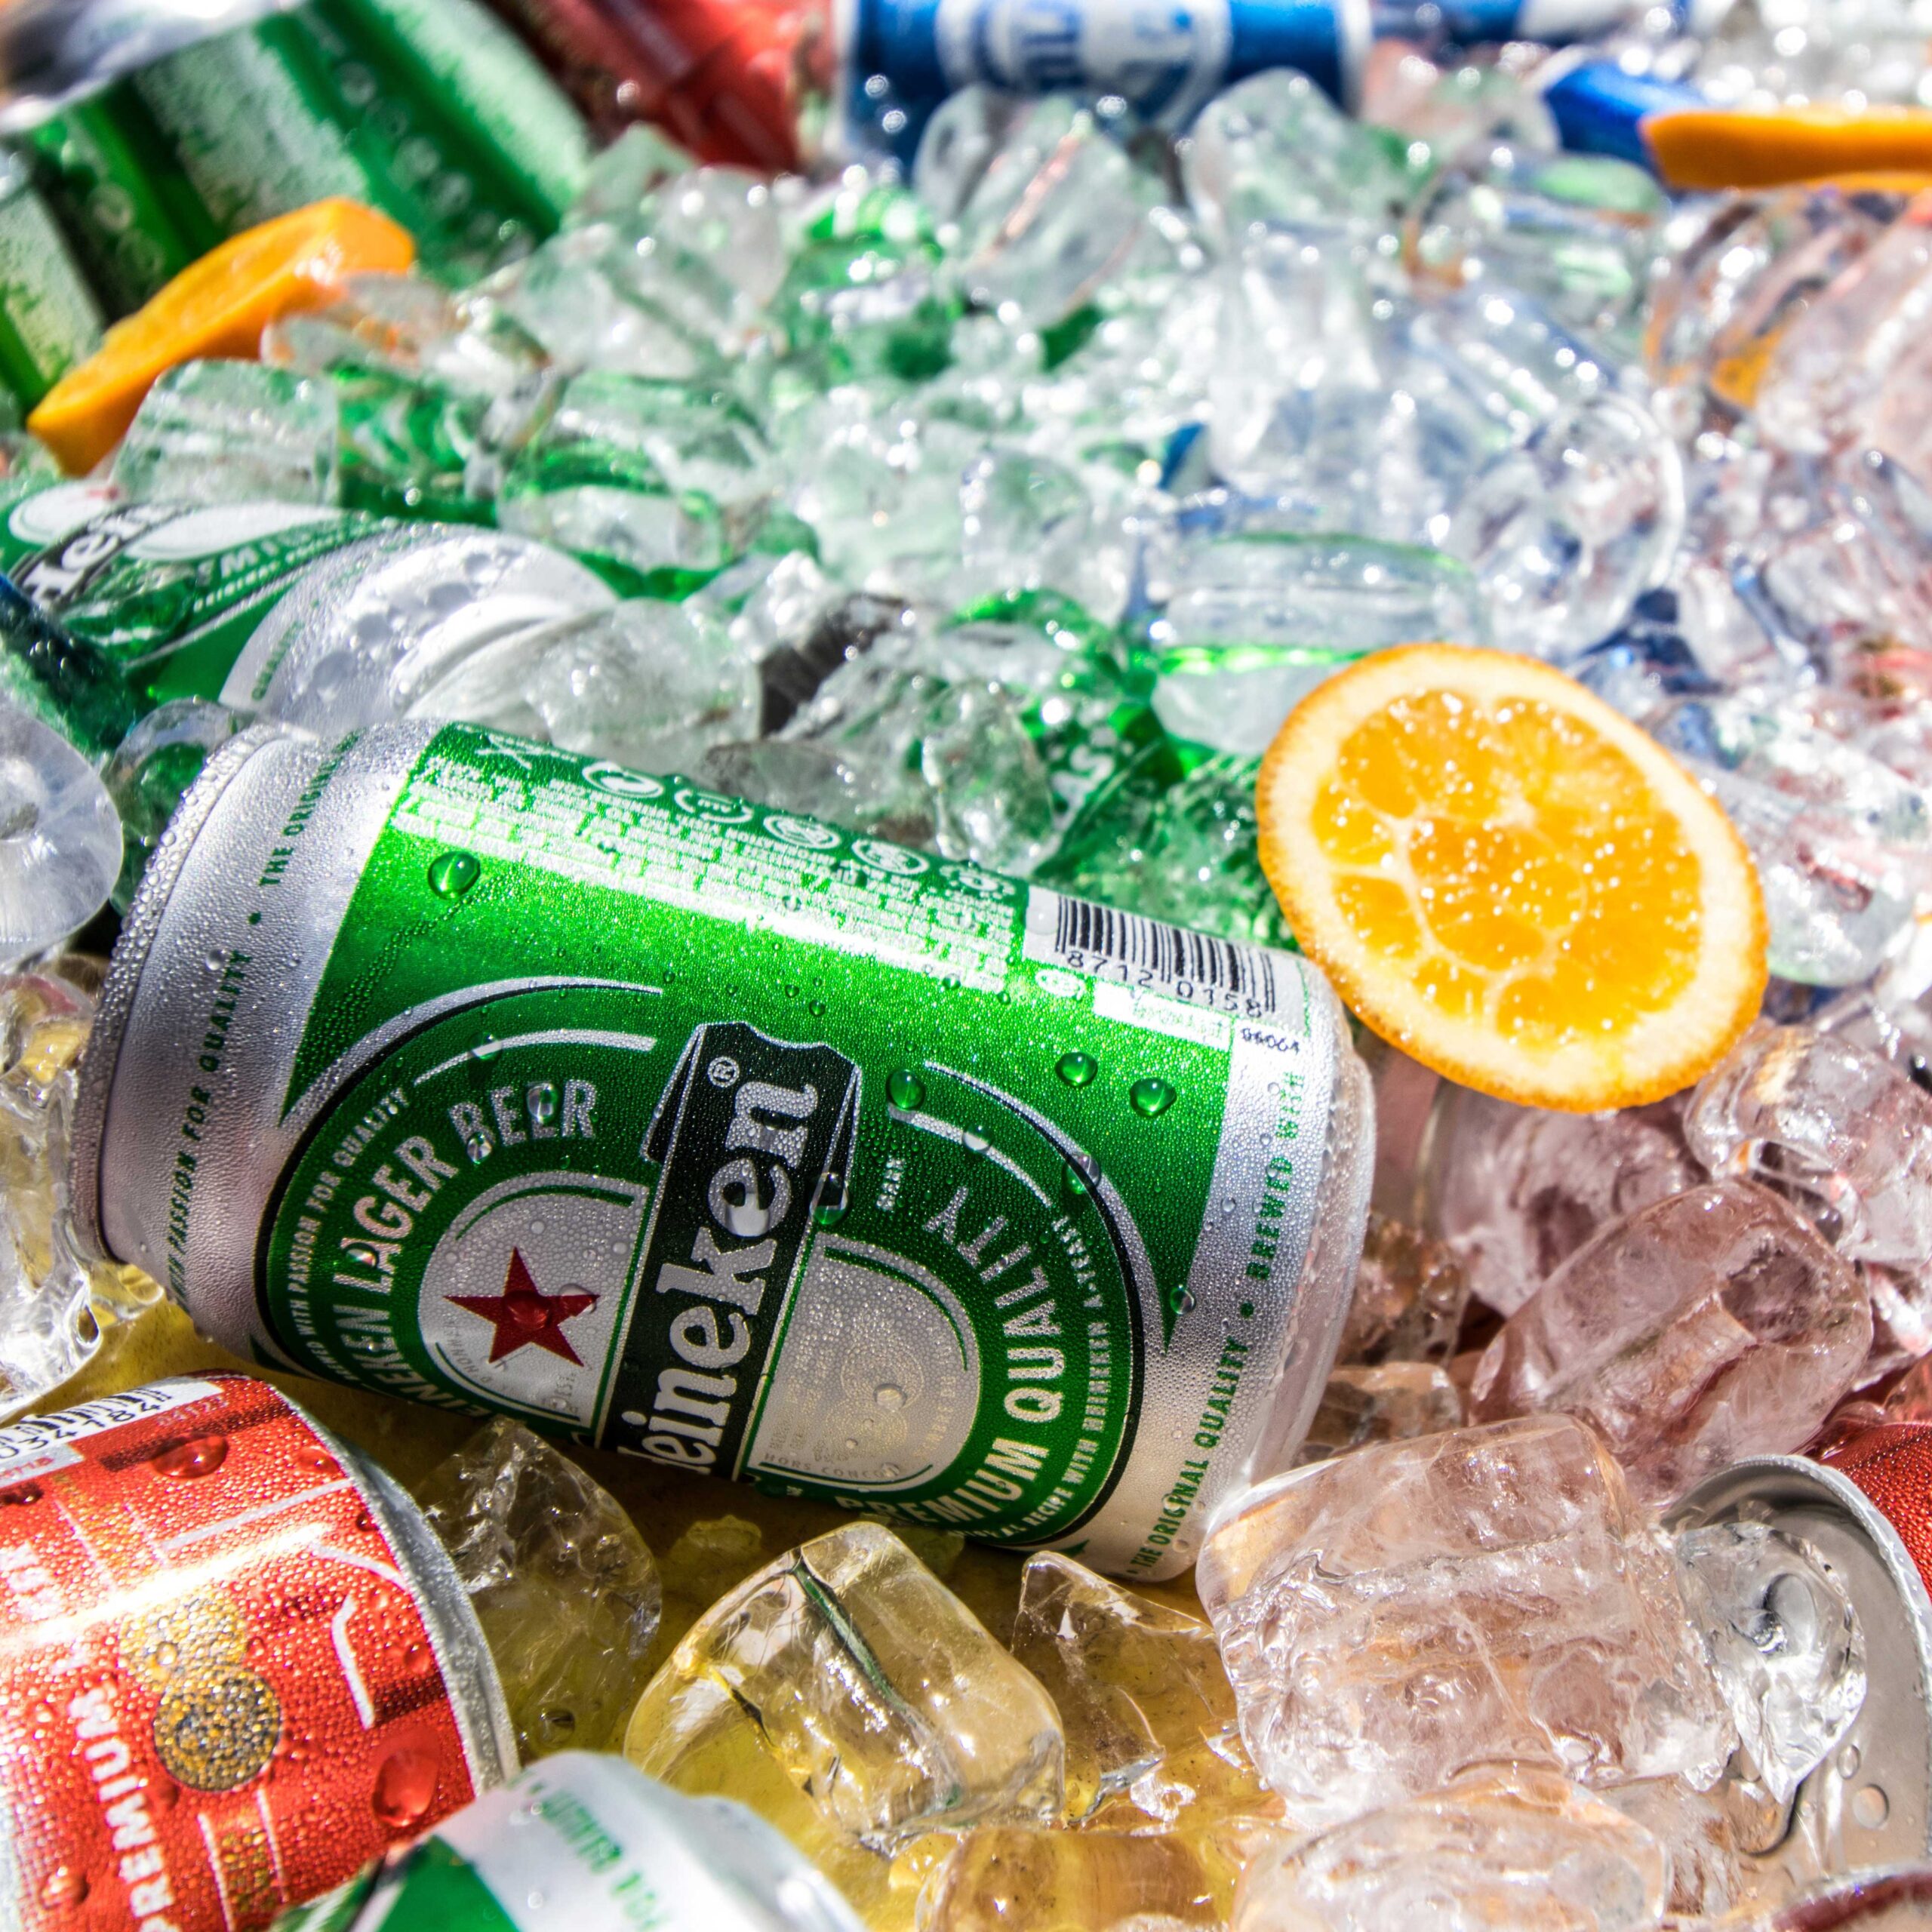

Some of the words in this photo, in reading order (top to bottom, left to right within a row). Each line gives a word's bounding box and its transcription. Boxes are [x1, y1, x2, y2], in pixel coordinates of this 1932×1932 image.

[257, 845, 294, 888] THE
[166, 1155, 198, 1259] PASSION
[182, 1084, 212, 1143] FOR
[199, 948, 254, 1075] QUALITY
[332, 1085, 410, 1169] QUALITY
[307, 1171, 343, 1213] FOR
[333, 1135, 459, 1295] LAGER
[288, 1214, 322, 1292] PASSION
[288, 1298, 318, 1337] WITH
[922, 1186, 1066, 1423] QUALITY
[332, 1303, 494, 1420] EINEKEN
[1131, 1546, 1155, 1571] THE
[1148, 1458, 1209, 1548] ORIGINAL
[1195, 1334, 1250, 1449] QUALITY
[1245, 1155, 1294, 1281] BREWED
[1022, 1485, 1075, 1527] RECIPE
[1061, 1438, 1100, 1485] WITH
[1081, 1321, 1112, 1433] HEINEKEN
[834, 1437, 1051, 1525] PREMIUM
